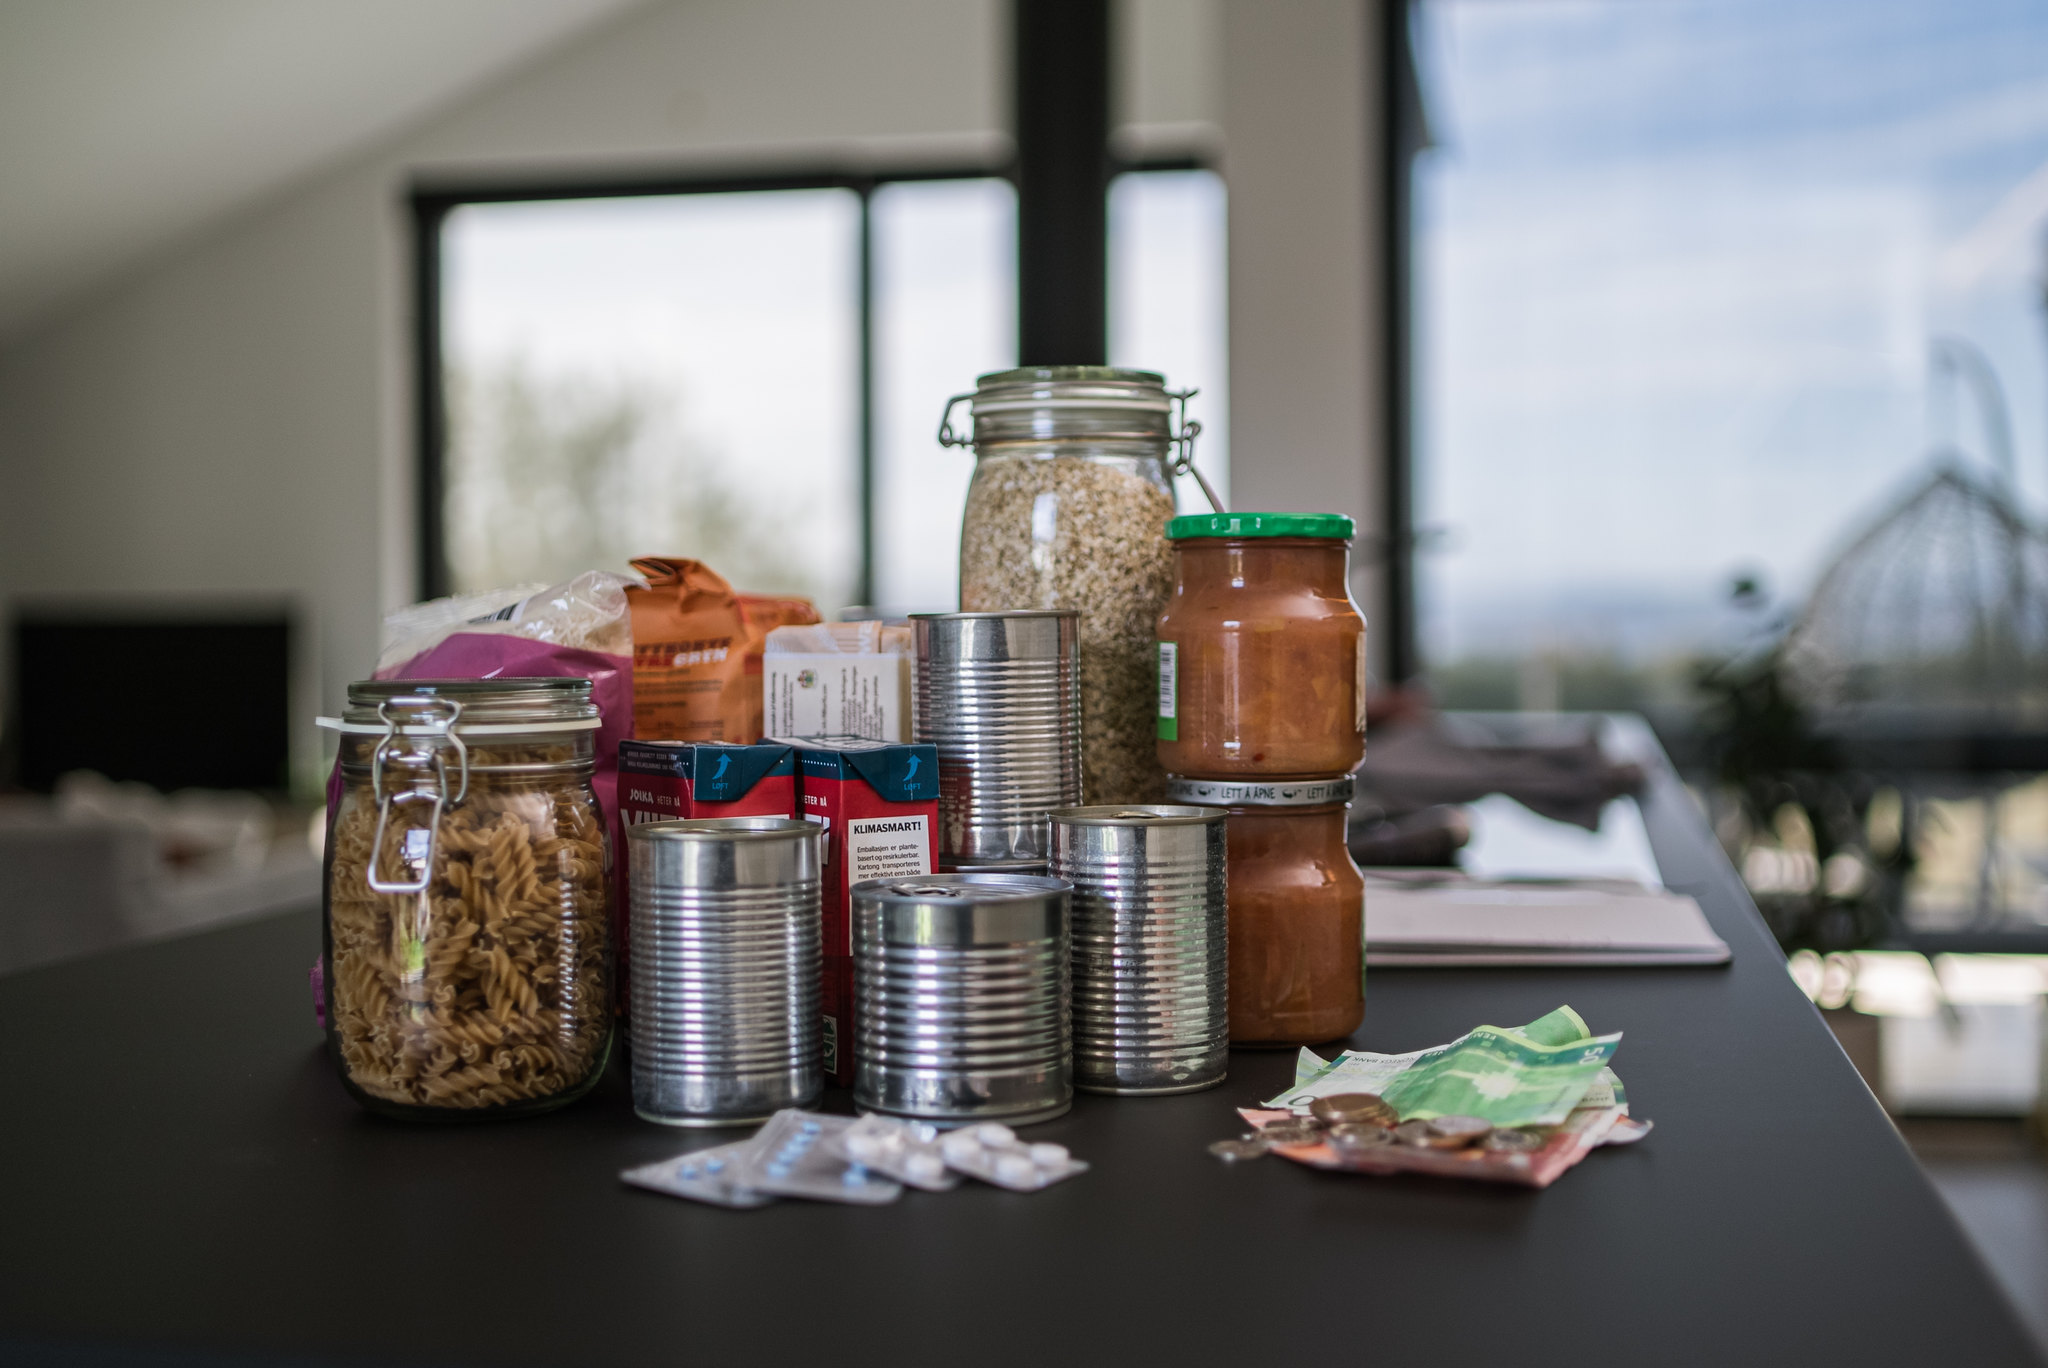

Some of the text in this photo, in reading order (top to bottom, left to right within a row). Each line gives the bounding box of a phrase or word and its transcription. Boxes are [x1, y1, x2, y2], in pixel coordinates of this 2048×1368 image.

[1221, 786, 1276, 799] LETT Å ÅPNE
[1307, 786, 1325, 799] LETT
[803, 794, 818, 805] ETER
[854, 821, 921, 835] KLIMASMART!
[857, 845, 889, 854] Emballasjen
[898, 843, 919, 852] plante-
[883, 852, 920, 860] resirkulerbar.
[857, 860, 920, 871] Kartong transporteres
[870, 870, 893, 878] effektivt
